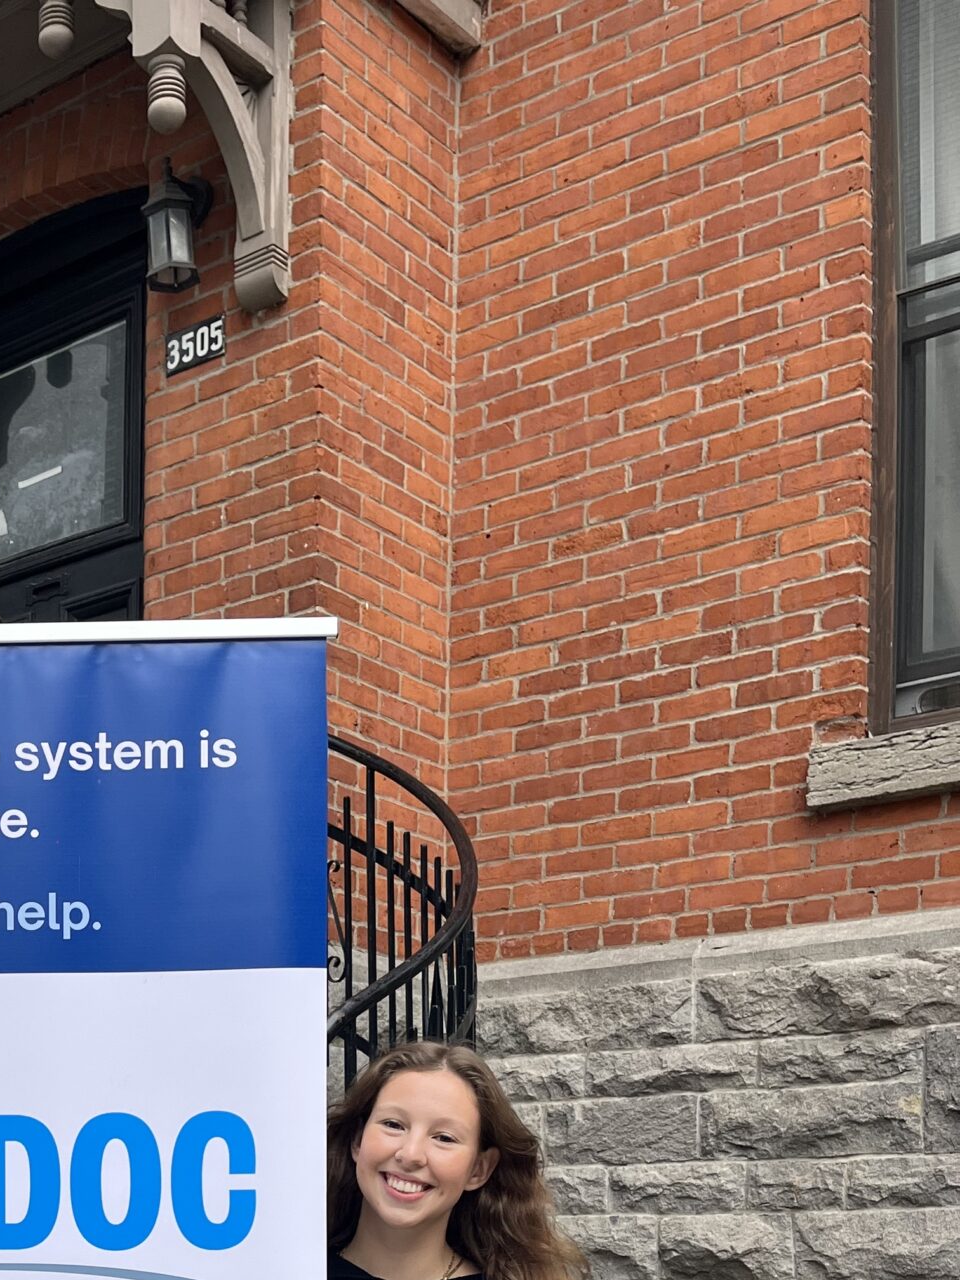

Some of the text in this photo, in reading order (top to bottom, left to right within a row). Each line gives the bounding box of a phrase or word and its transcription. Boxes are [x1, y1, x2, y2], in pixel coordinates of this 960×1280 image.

[167, 319, 224, 370] 3505
[15, 733, 183, 780] system
[200, 730, 236, 768] is
